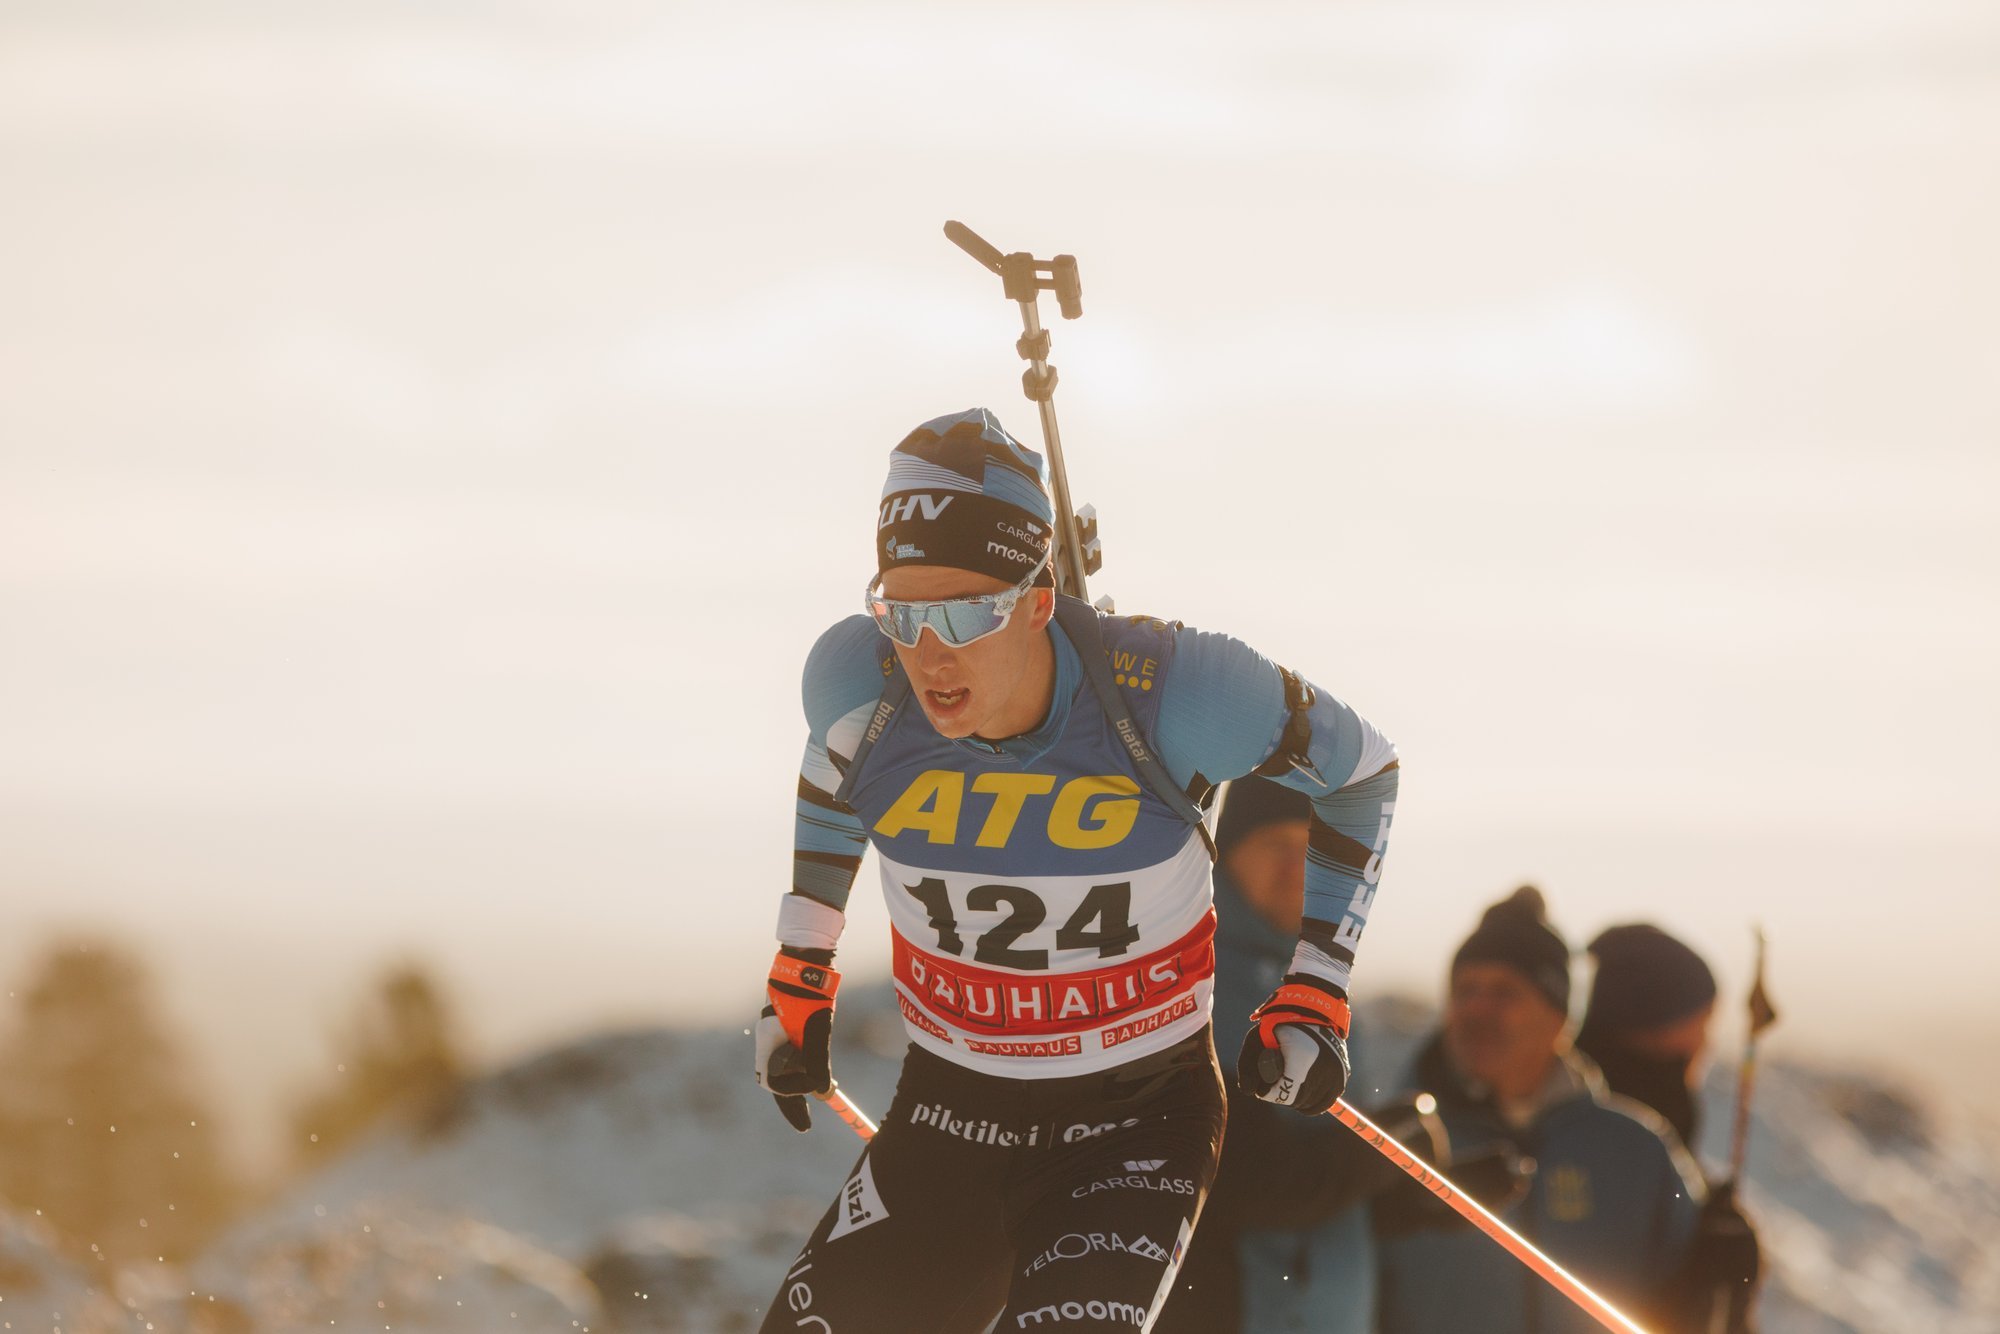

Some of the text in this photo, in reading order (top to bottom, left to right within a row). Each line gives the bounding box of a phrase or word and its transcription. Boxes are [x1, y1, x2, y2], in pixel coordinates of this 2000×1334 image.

[880, 495, 954, 529] LHV
[1116, 718, 1150, 762] biatar
[873, 770, 1141, 850] ATG
[903, 877, 1140, 970] 124
[1104, 996, 1195, 1046] BAUHAUS
[967, 1038, 1080, 1053] BAUHAUS
[910, 1103, 1040, 1147] piletilevi
[847, 1178, 872, 1226] iizi
[1072, 1175, 1195, 1199] CARGLASS
[1024, 1232, 1128, 1277] TELORA
